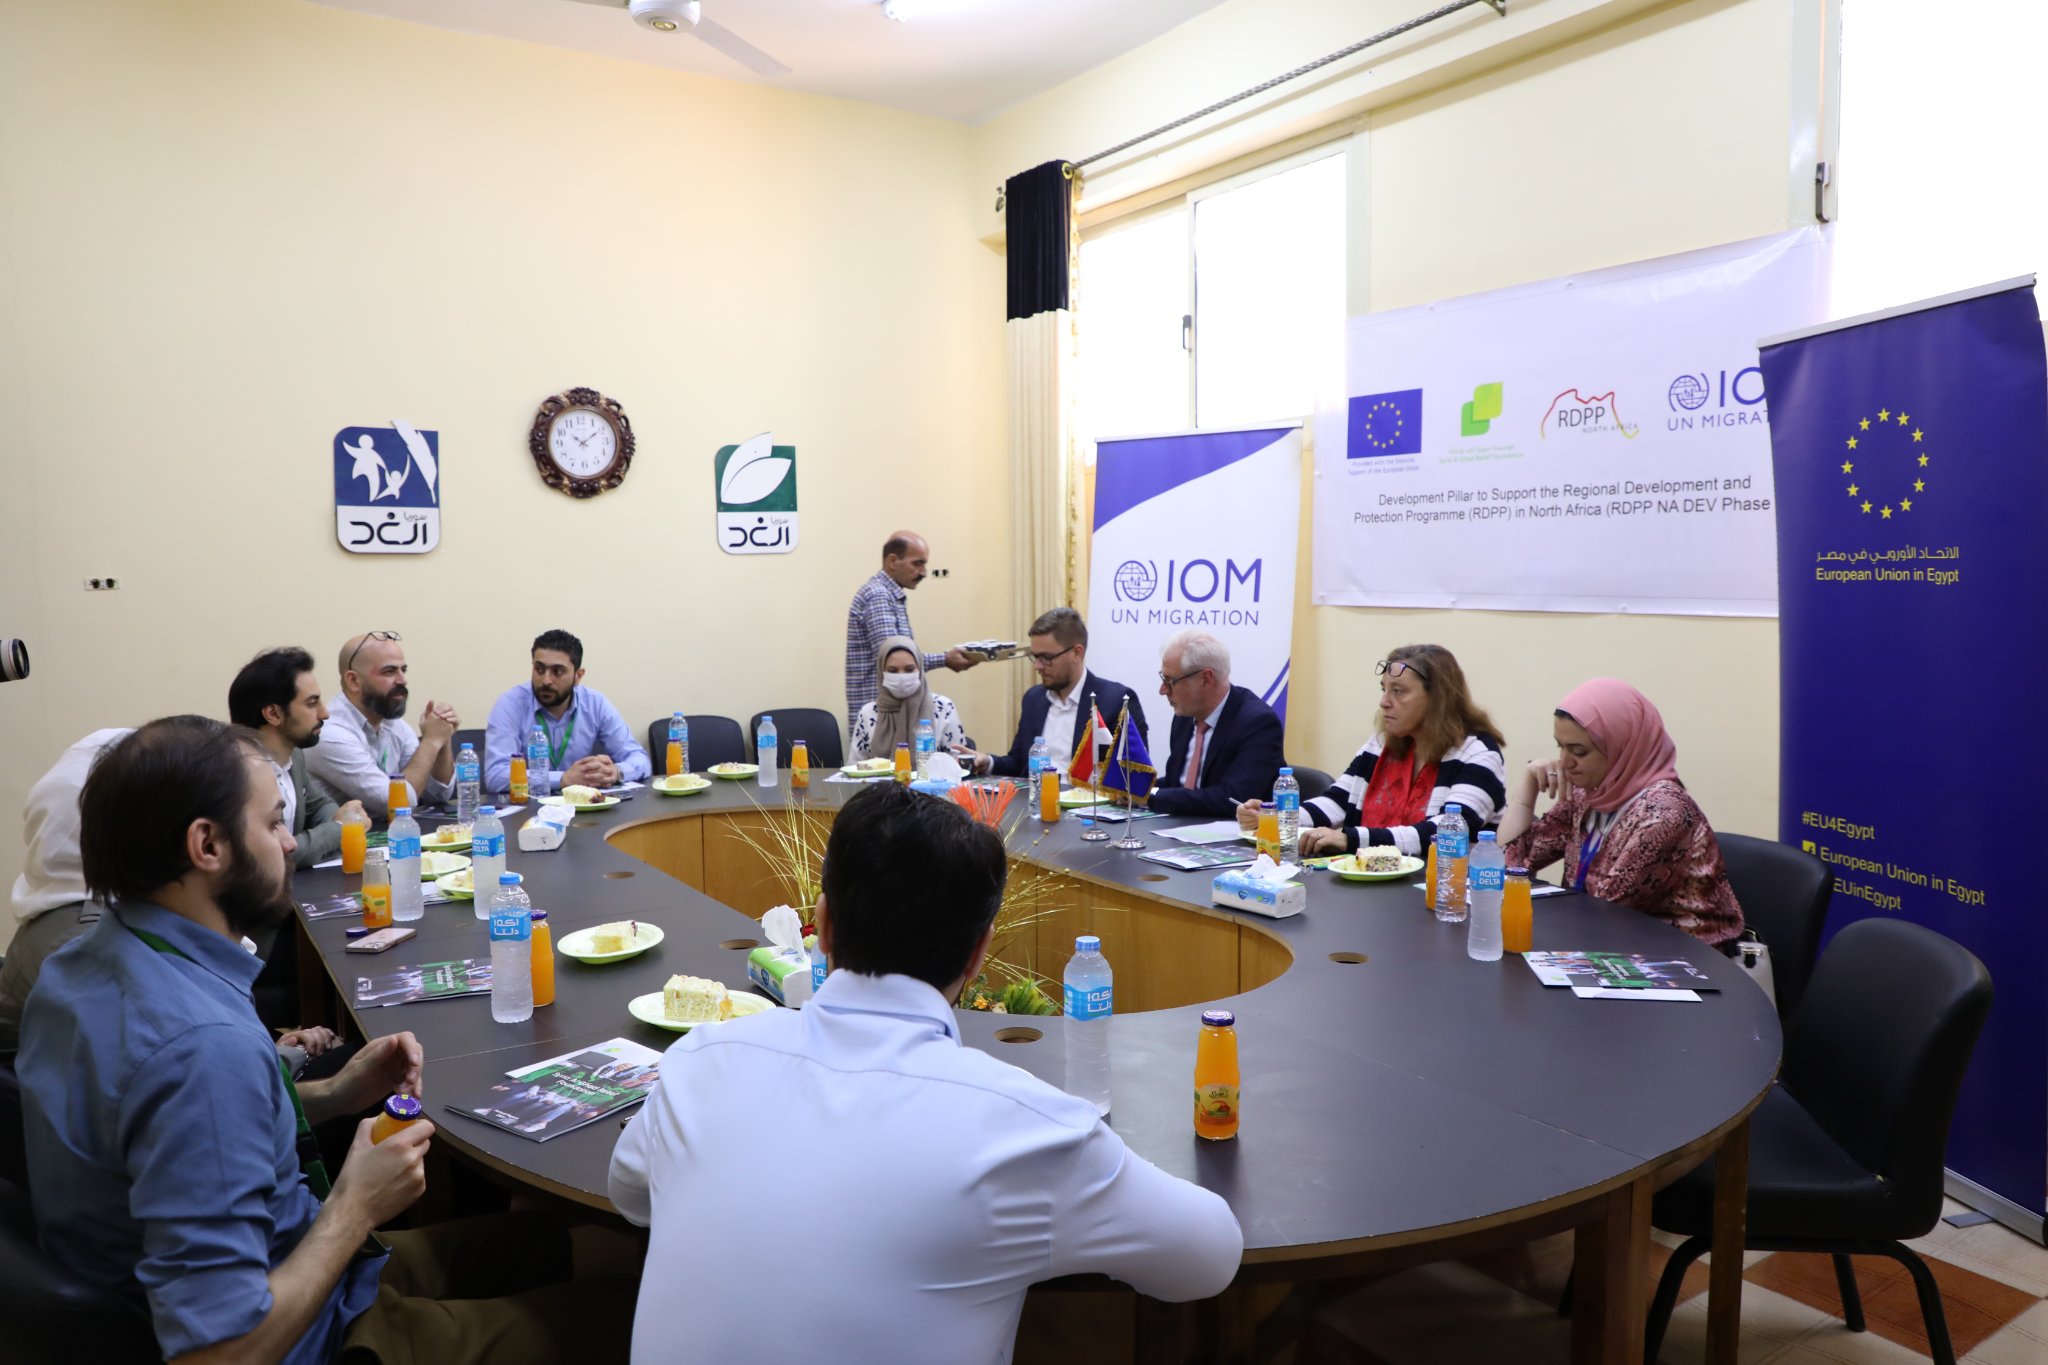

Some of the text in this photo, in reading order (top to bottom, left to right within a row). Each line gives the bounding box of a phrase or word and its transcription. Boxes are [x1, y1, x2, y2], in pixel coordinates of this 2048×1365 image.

[1719, 366, 1767, 408] IO
[1558, 406, 1606, 429] RDPP
[1667, 409, 1769, 431] UN MIGRAT
[1582, 425, 1608, 434] NORTH
[1378, 475, 1751, 507] Development Pillar to Support the Regional Development and
[1354, 497, 1771, 524] Protection Programme (RDPP) in North Africa (RDPP NA DEV Phase
[350, 511, 427, 545] الغد
[728, 516, 790, 547] الغد
[1816, 544, 1960, 565] الاتحاد الأوروبي في مصر
[1167, 558, 1262, 603] IOM
[1816, 567, 1959, 585] European Union in Egypt
[1111, 608, 1260, 626] UN MIGRATION
[1801, 810, 1876, 840] #EU4Egypt
[1479, 870, 1501, 878] AQUA
[1479, 877, 1501, 886] DELTA
[1820, 846, 1986, 906] European Union in Egypt
[493, 927, 520, 936] دلتا
